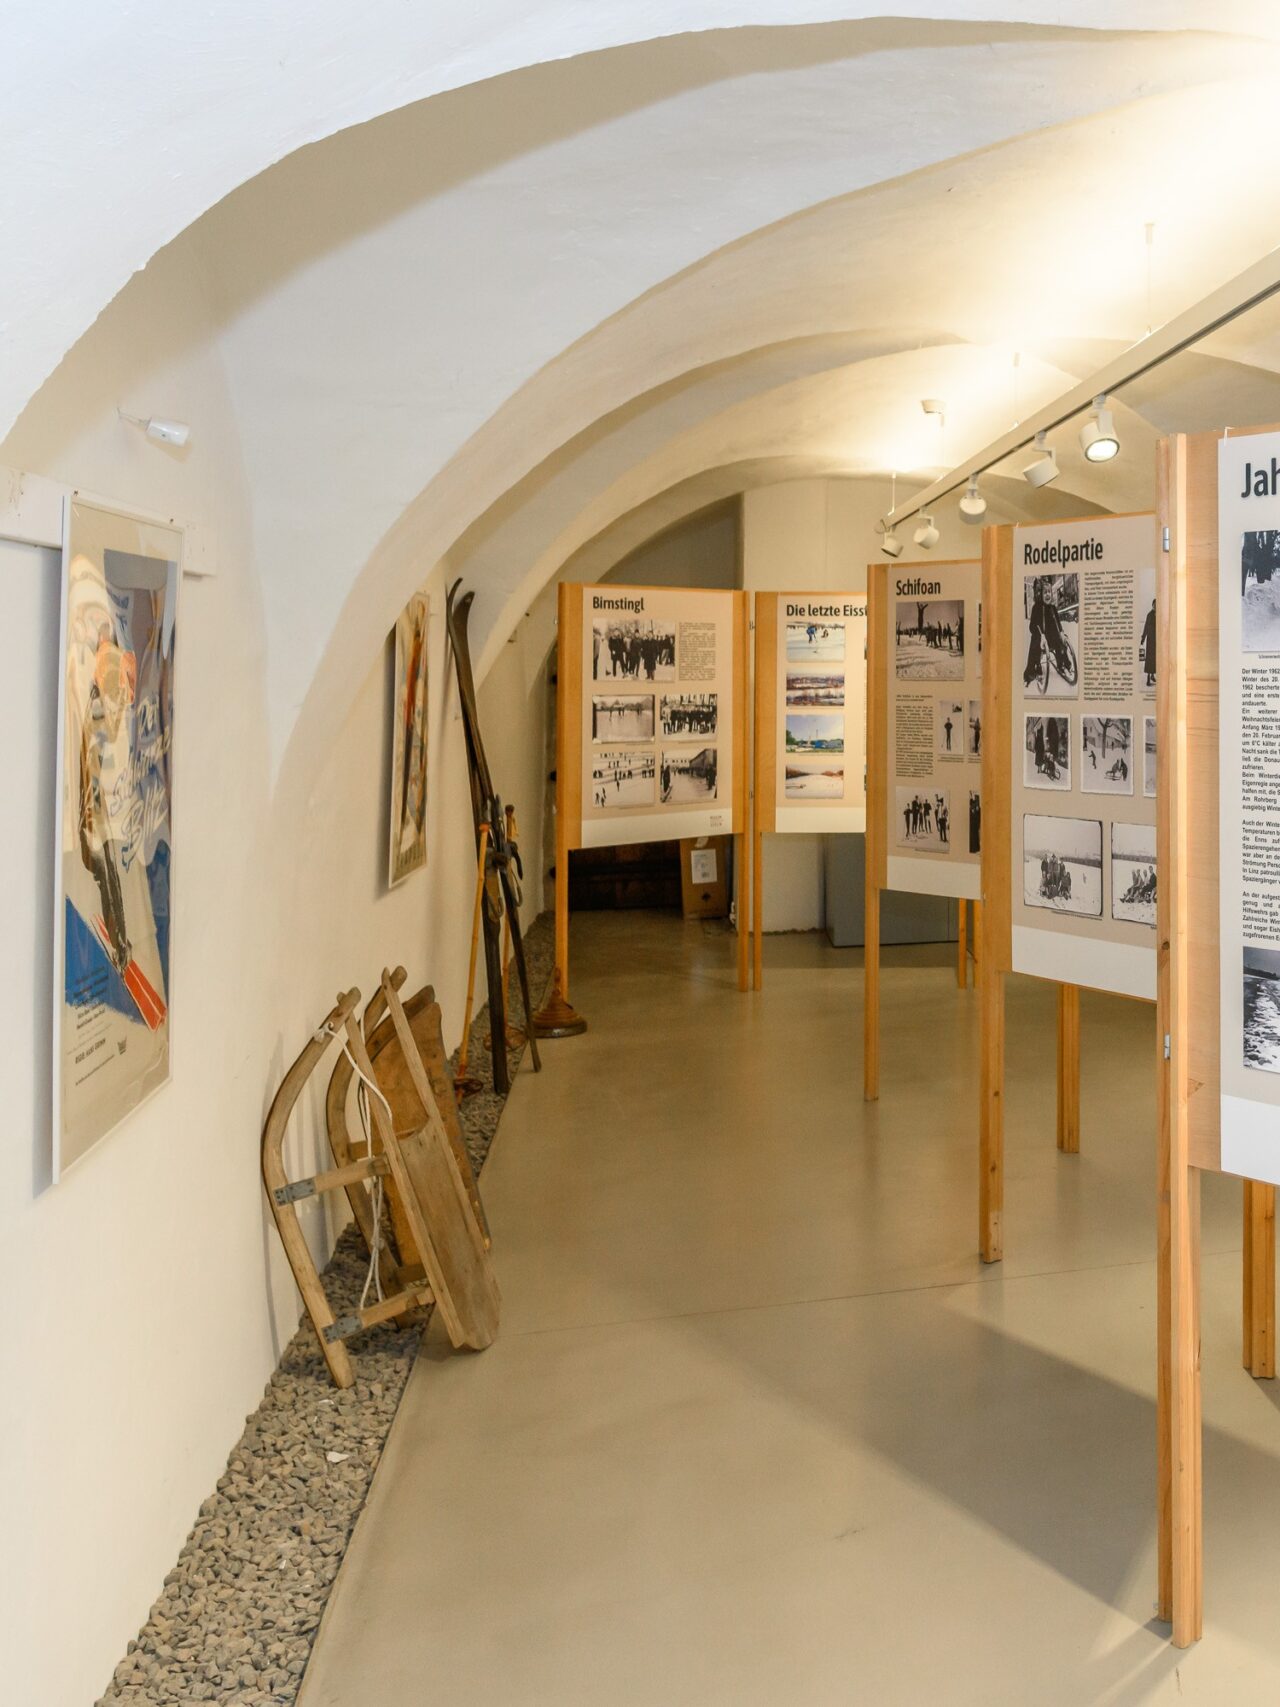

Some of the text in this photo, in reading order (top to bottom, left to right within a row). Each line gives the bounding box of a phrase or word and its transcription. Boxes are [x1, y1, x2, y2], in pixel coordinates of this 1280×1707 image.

[1024, 538, 1104, 568] Rodelpartie
[895, 577, 941, 597] Schifoan
[786, 604, 805, 617] Die
[808, 604, 840, 617] letzte
